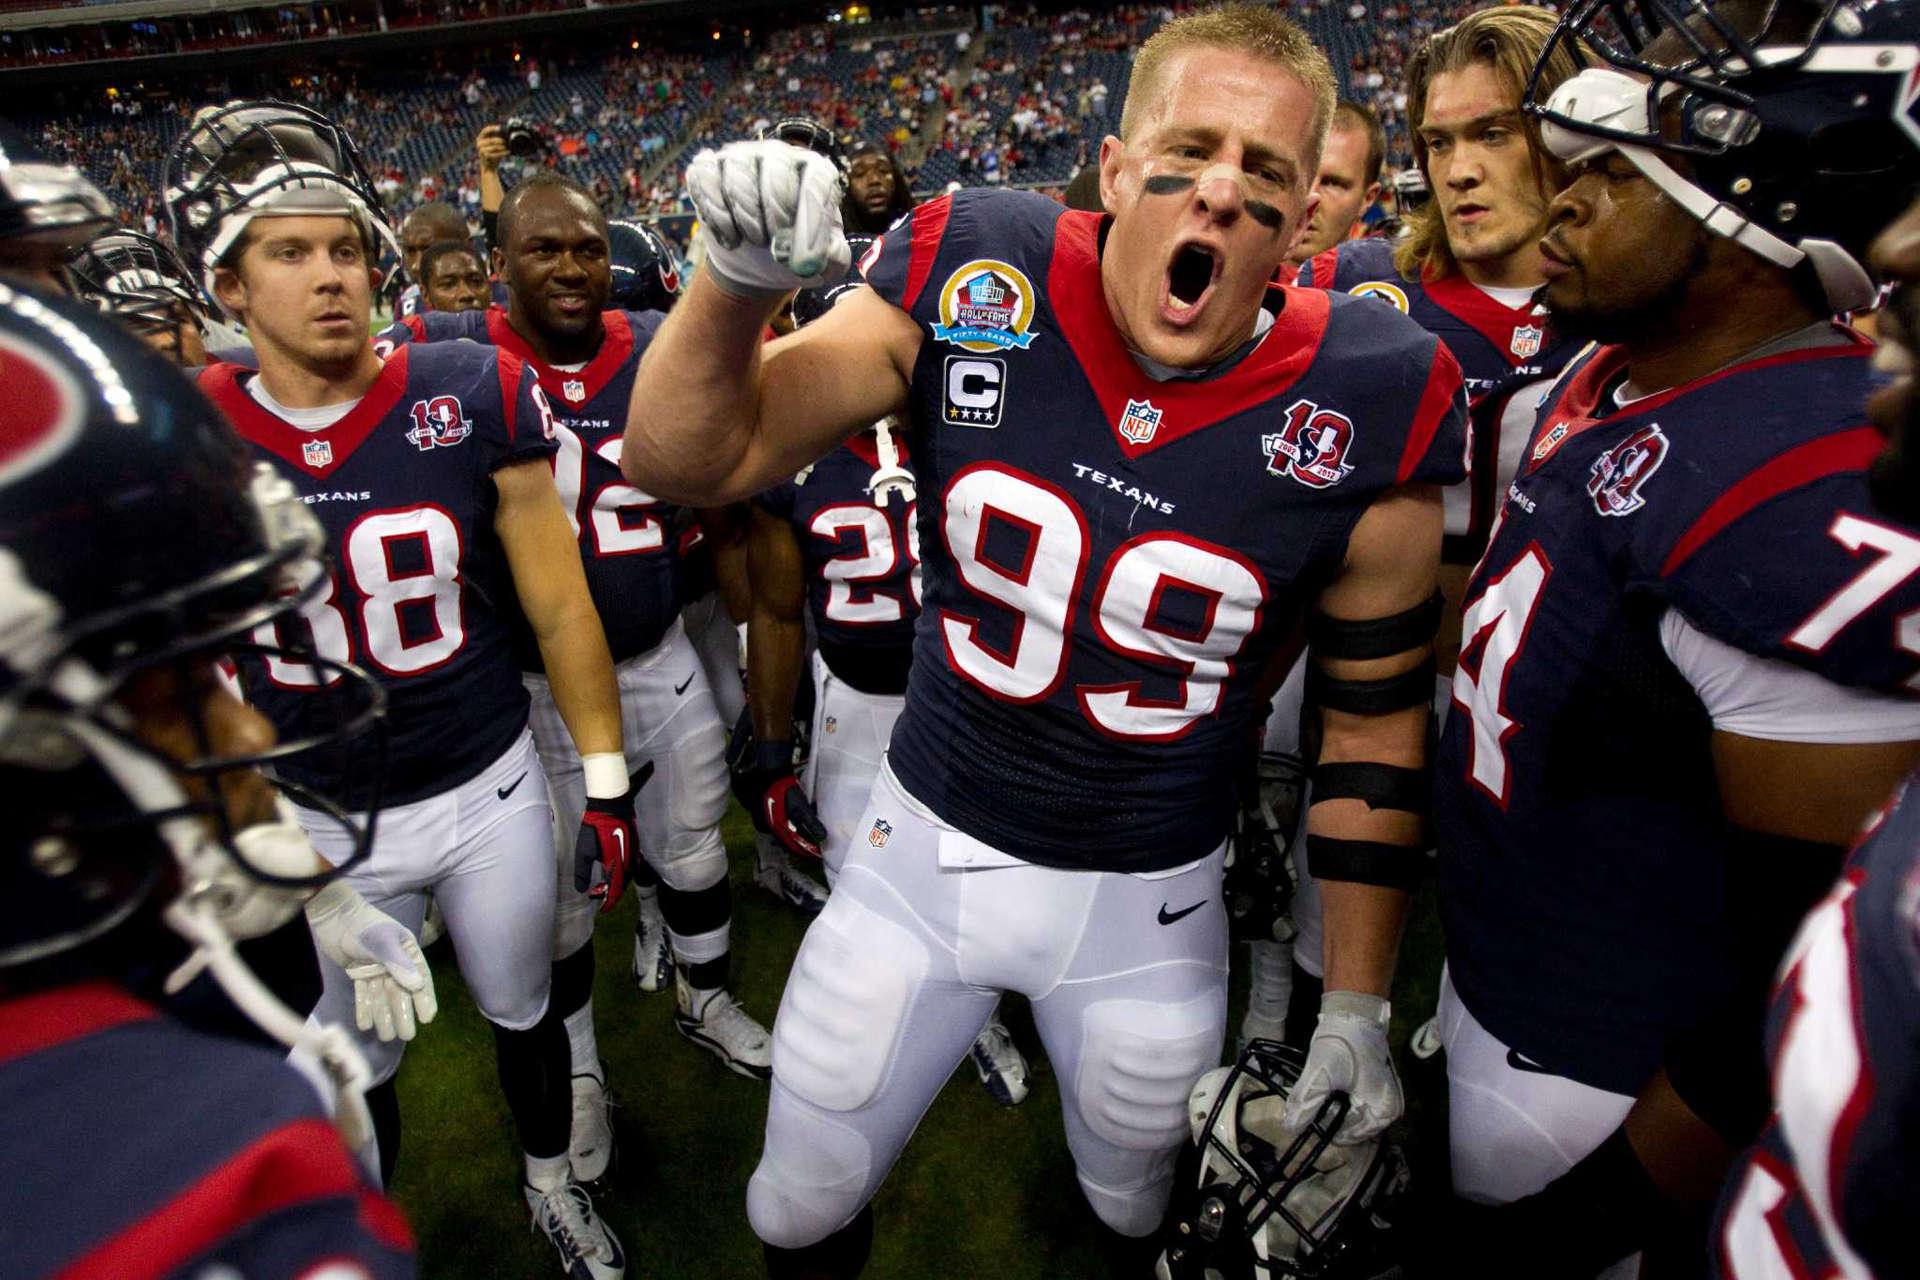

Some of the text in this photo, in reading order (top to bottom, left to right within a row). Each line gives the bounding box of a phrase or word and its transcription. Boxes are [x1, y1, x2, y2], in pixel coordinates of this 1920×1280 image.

[948, 360, 1001, 409] C
[1464, 366, 1543, 389] TENS
[561, 419, 610, 428] EXANS
[1071, 462, 1176, 514] TEXANS
[808, 502, 924, 627] 2
[938, 460, 1272, 744] 99
[1781, 509, 1920, 692] 7
[1452, 507, 1554, 812] 4
